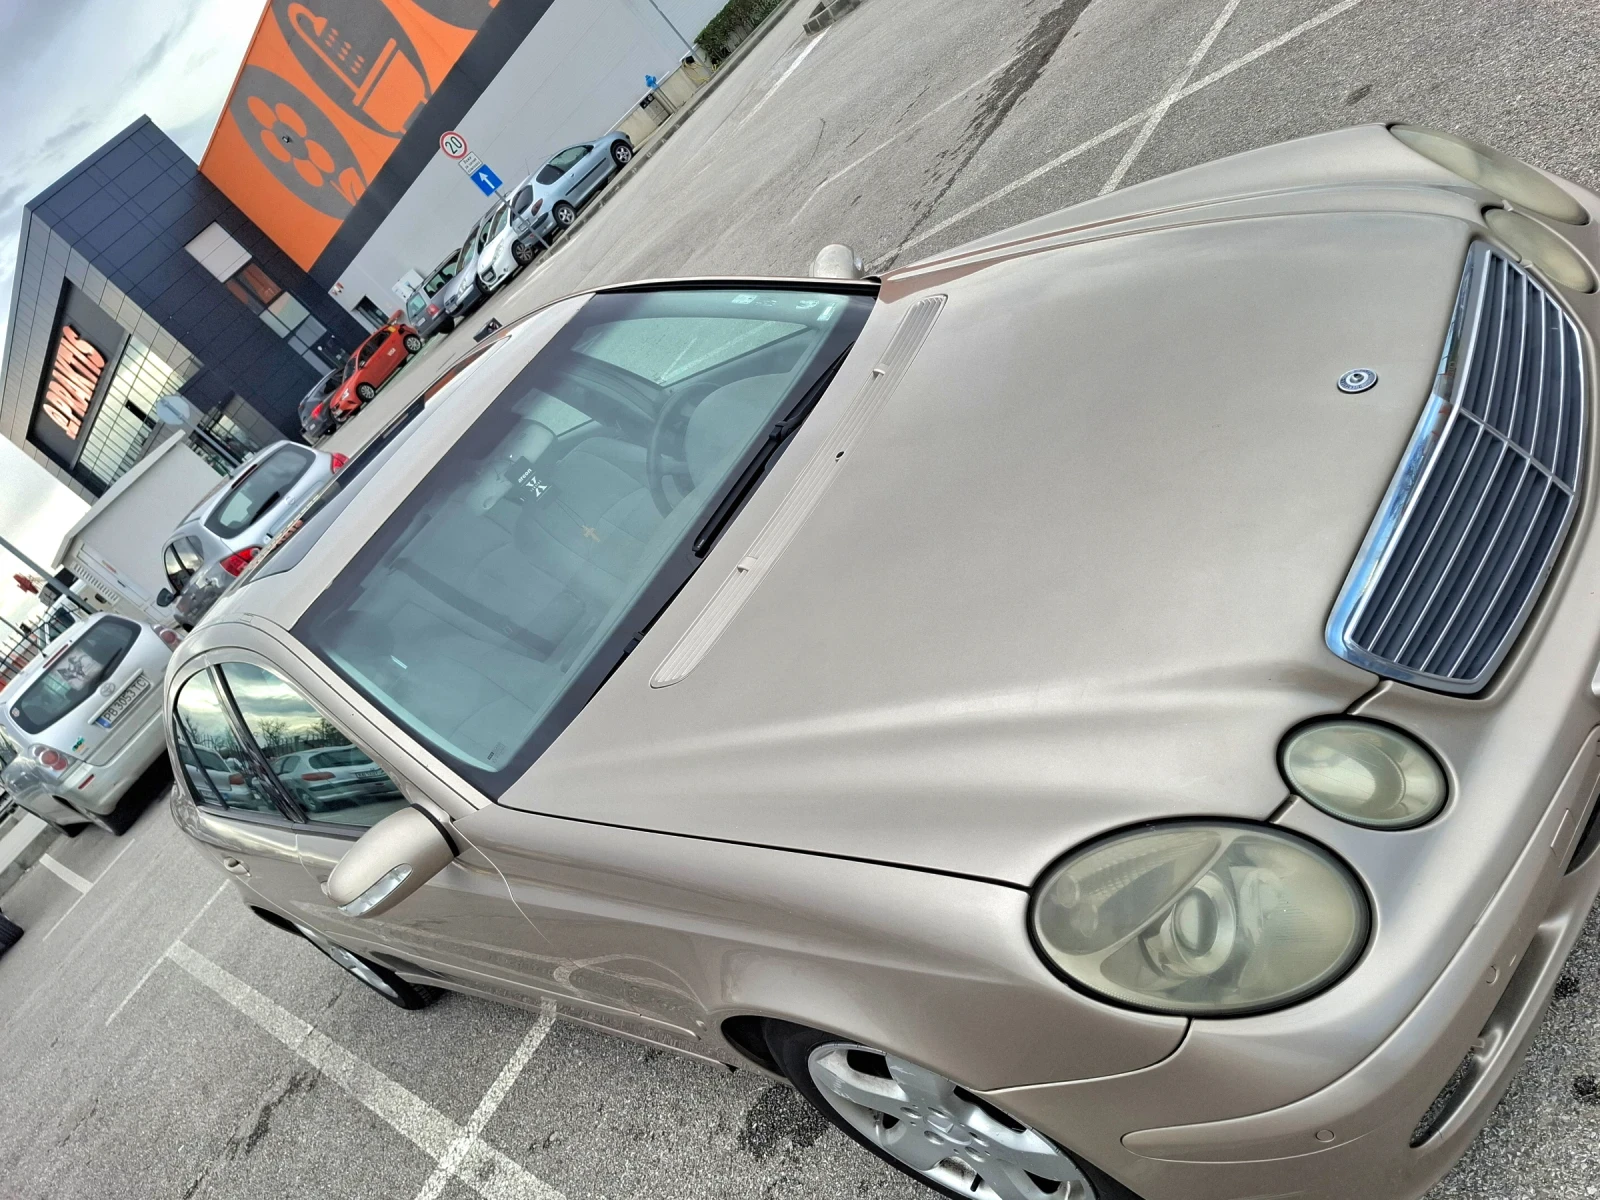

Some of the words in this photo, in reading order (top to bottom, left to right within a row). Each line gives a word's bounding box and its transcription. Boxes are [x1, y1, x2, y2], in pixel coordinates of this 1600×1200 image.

[445, 136, 462, 154] 20
[45, 325, 105, 427] PRAKTIS
[103, 707, 118, 722] PB
[114, 689, 136, 710] 3053
[131, 678, 147, 691] TC
